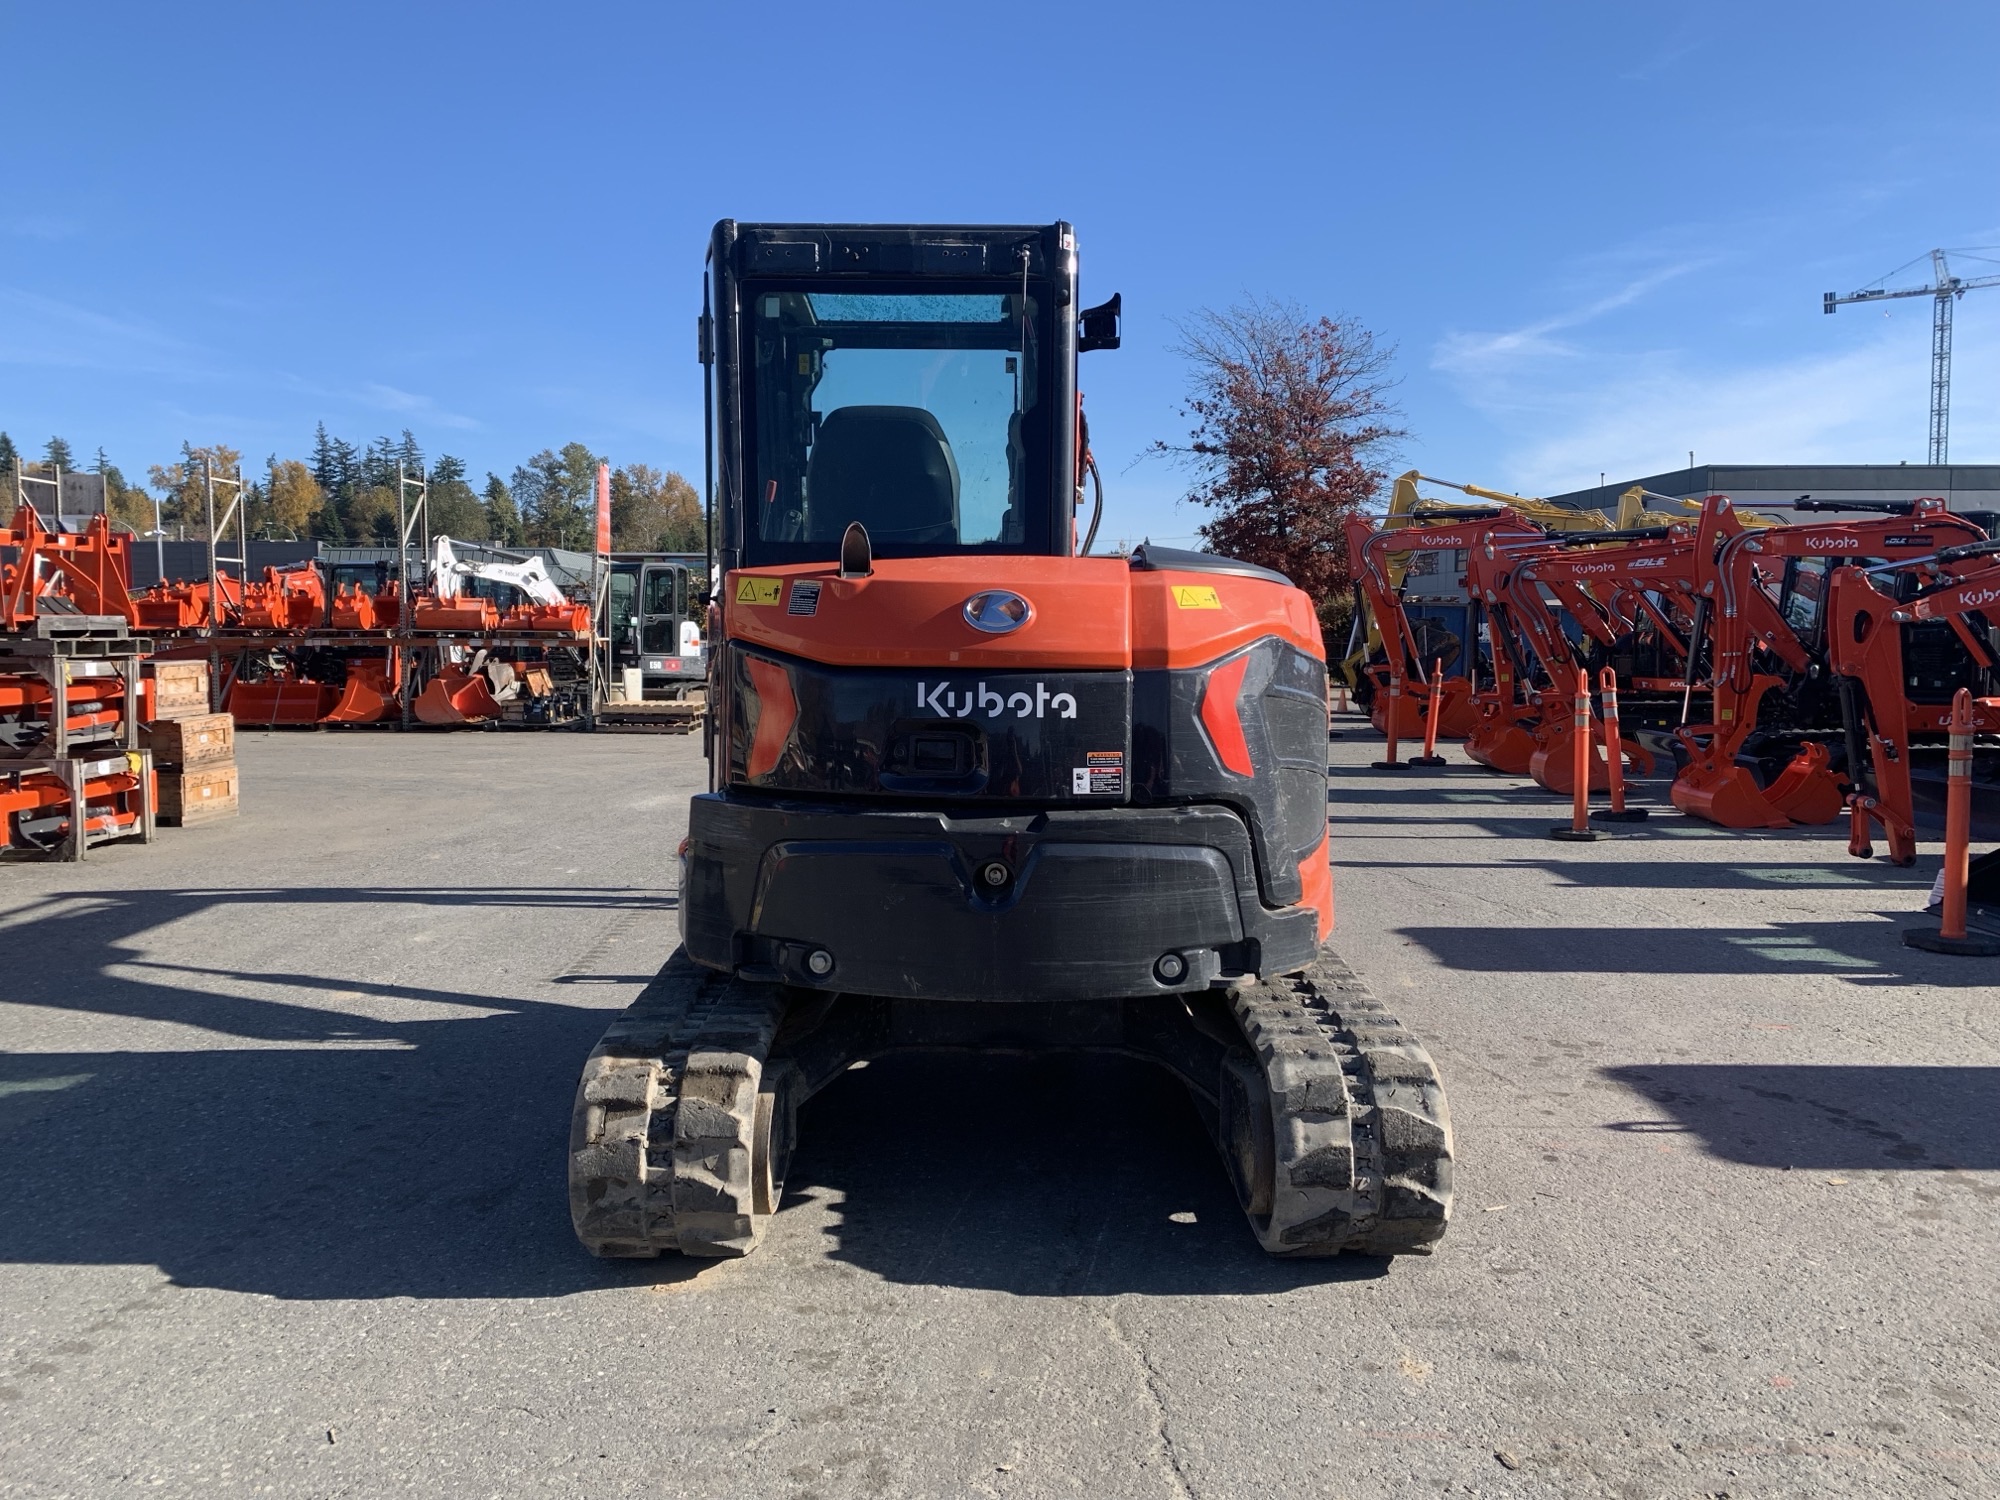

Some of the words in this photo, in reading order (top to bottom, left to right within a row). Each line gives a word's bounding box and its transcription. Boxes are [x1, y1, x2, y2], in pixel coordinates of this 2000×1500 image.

[1421, 535, 1463, 545] Kubota
[1806, 536, 1858, 549] Kubota
[1572, 562, 1616, 574] Kubota
[917, 681, 1077, 719] Kubota
